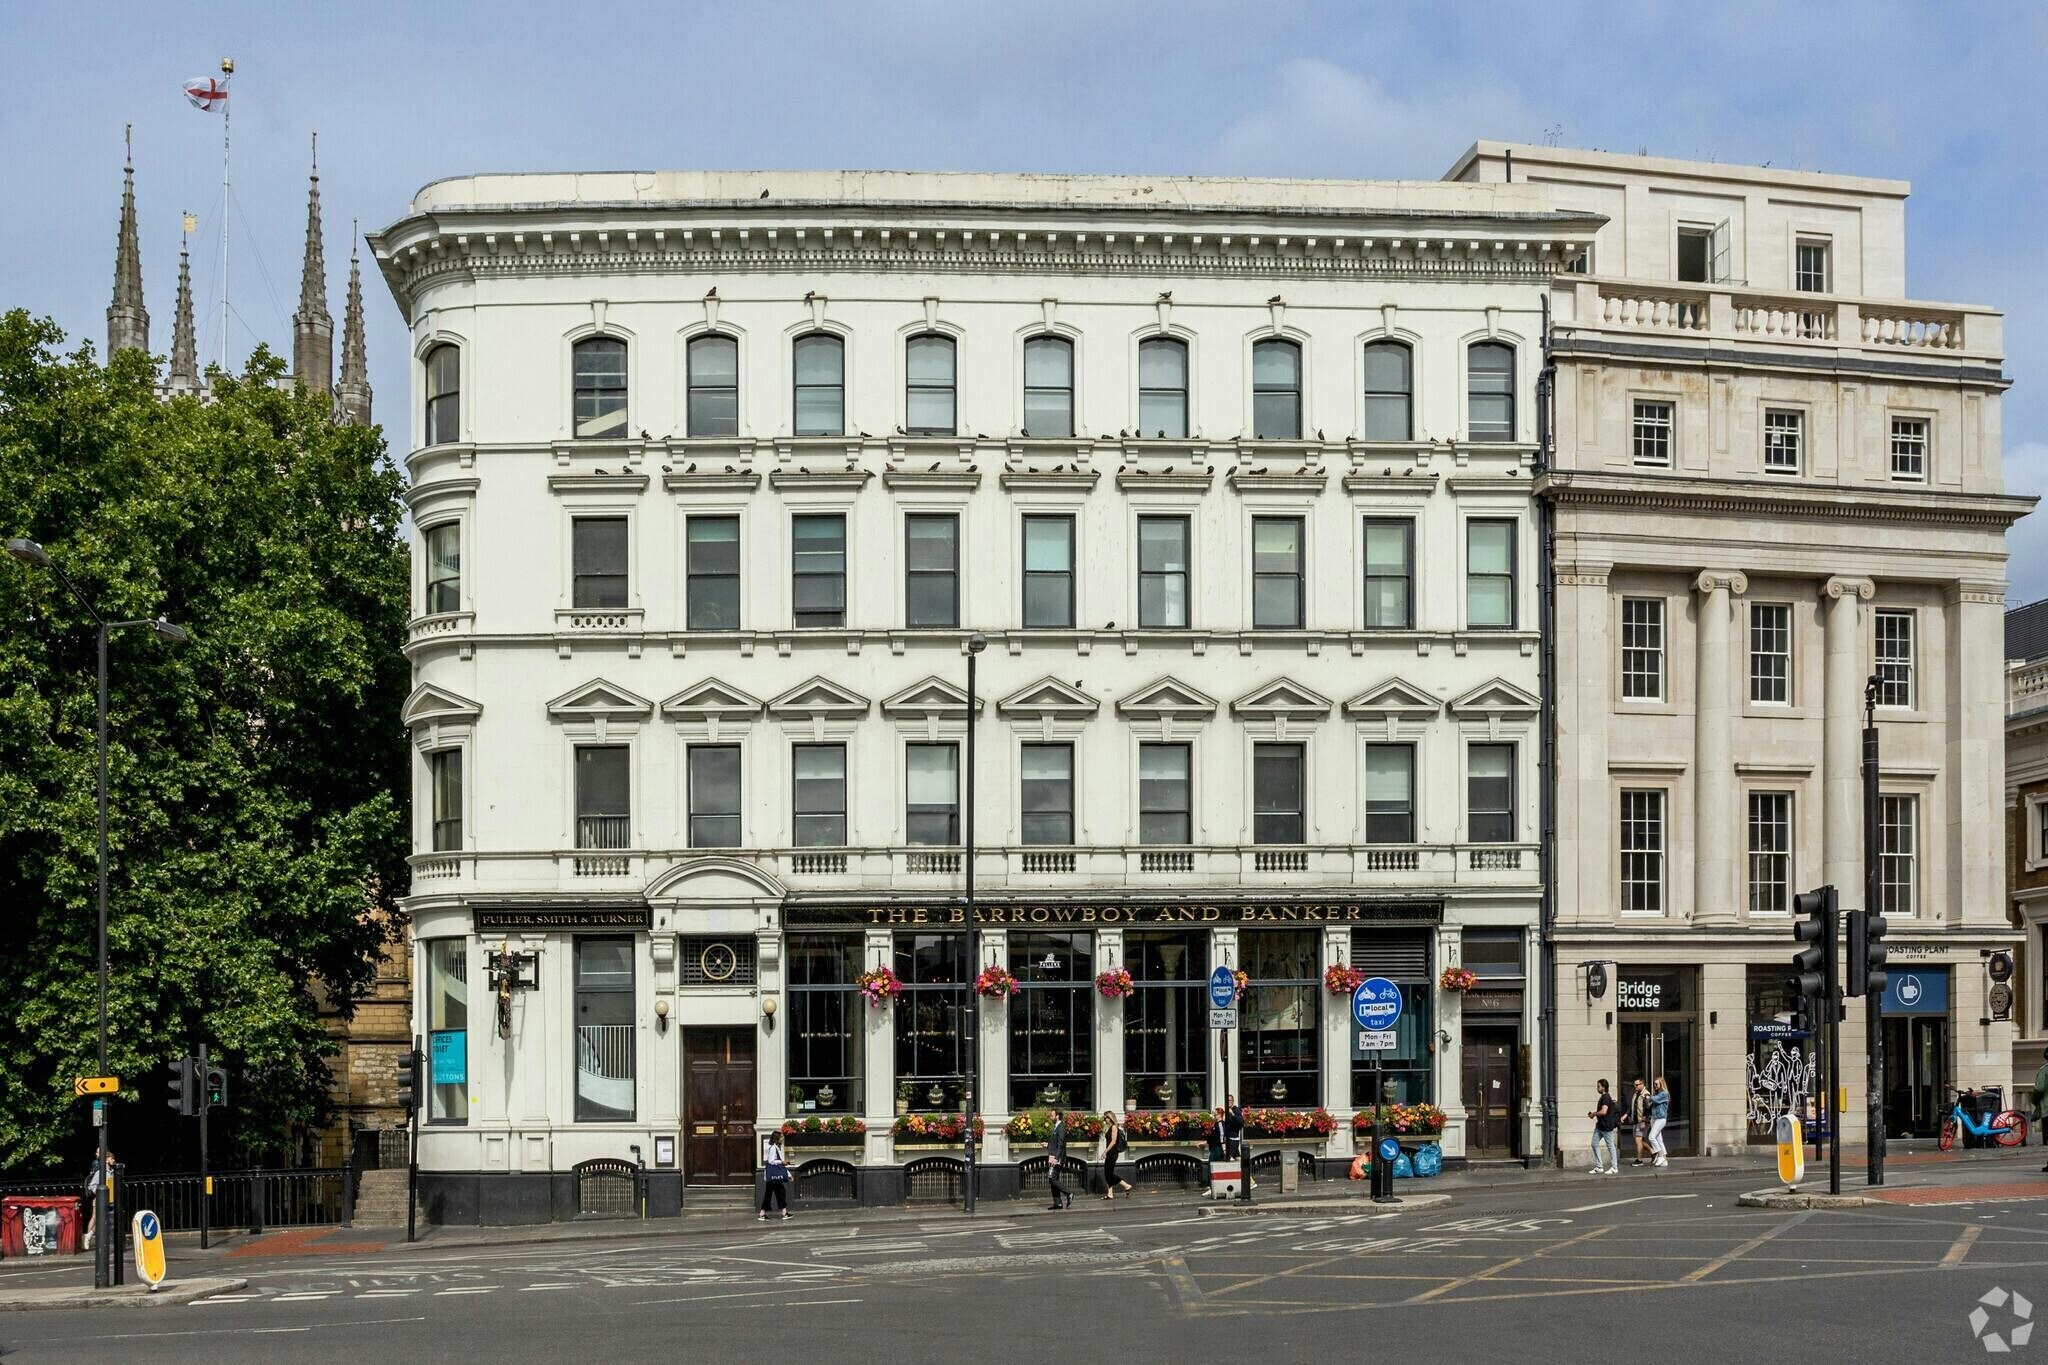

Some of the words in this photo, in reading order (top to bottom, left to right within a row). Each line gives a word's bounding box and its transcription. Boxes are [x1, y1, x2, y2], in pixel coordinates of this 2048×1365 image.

[536, 914, 578, 924] SMITH
[590, 914, 644, 924] TURNER
[867, 908, 929, 923] THE
[949, 906, 1142, 923] BARROWBOY
[1155, 906, 1221, 921] AND
[1240, 905, 1362, 920] BANKER
[1924, 945, 1950, 954] PLANT
[1617, 981, 1661, 997] Bridge
[1617, 994, 1660, 1008] House
